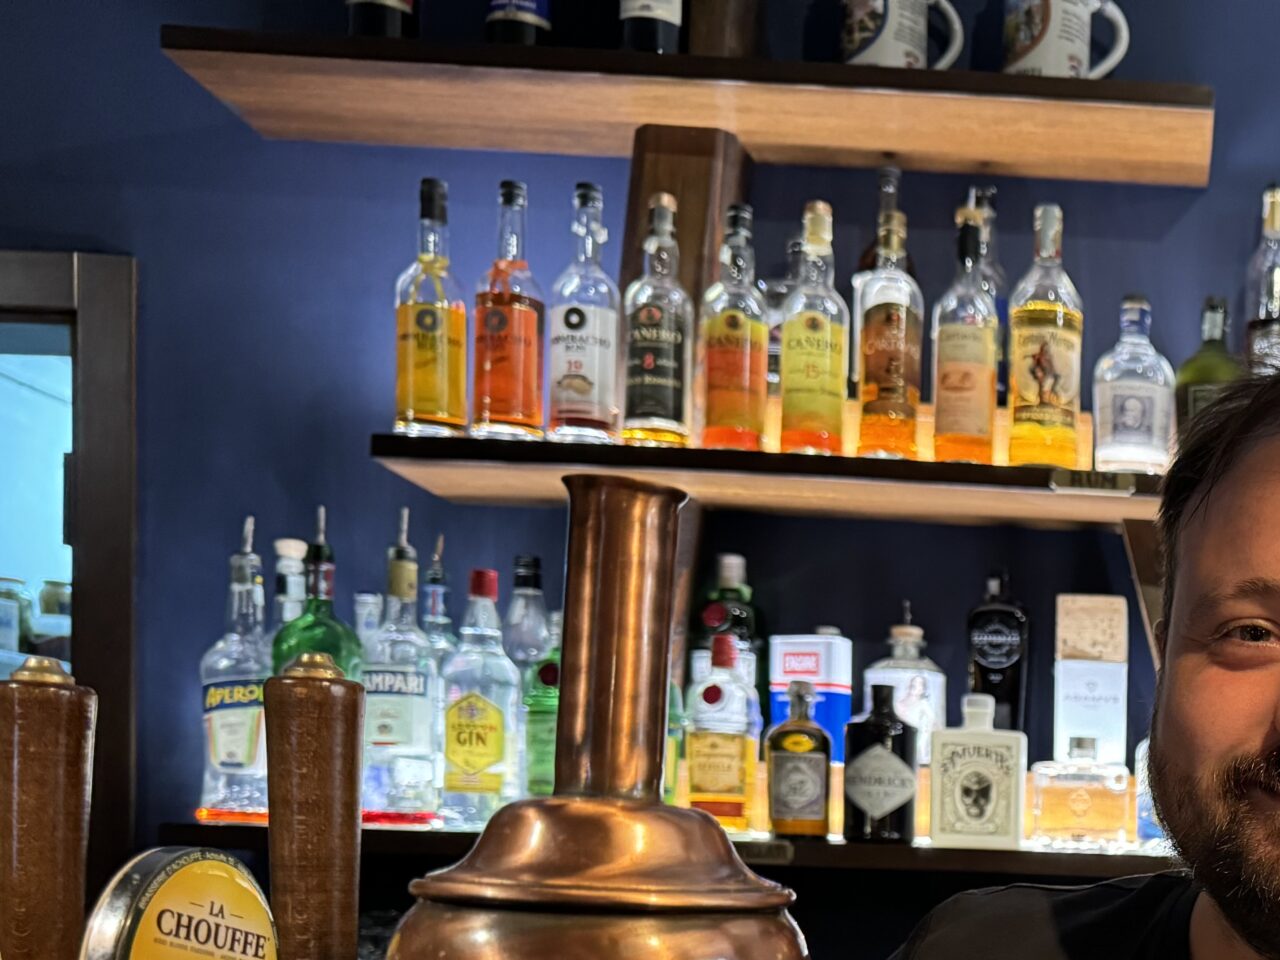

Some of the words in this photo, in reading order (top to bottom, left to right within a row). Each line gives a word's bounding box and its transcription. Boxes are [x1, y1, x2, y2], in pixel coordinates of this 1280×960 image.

[456, 731, 487, 746] GIN
[208, 900, 225, 919] LA
[156, 908, 267, 960] CHOUFFE
